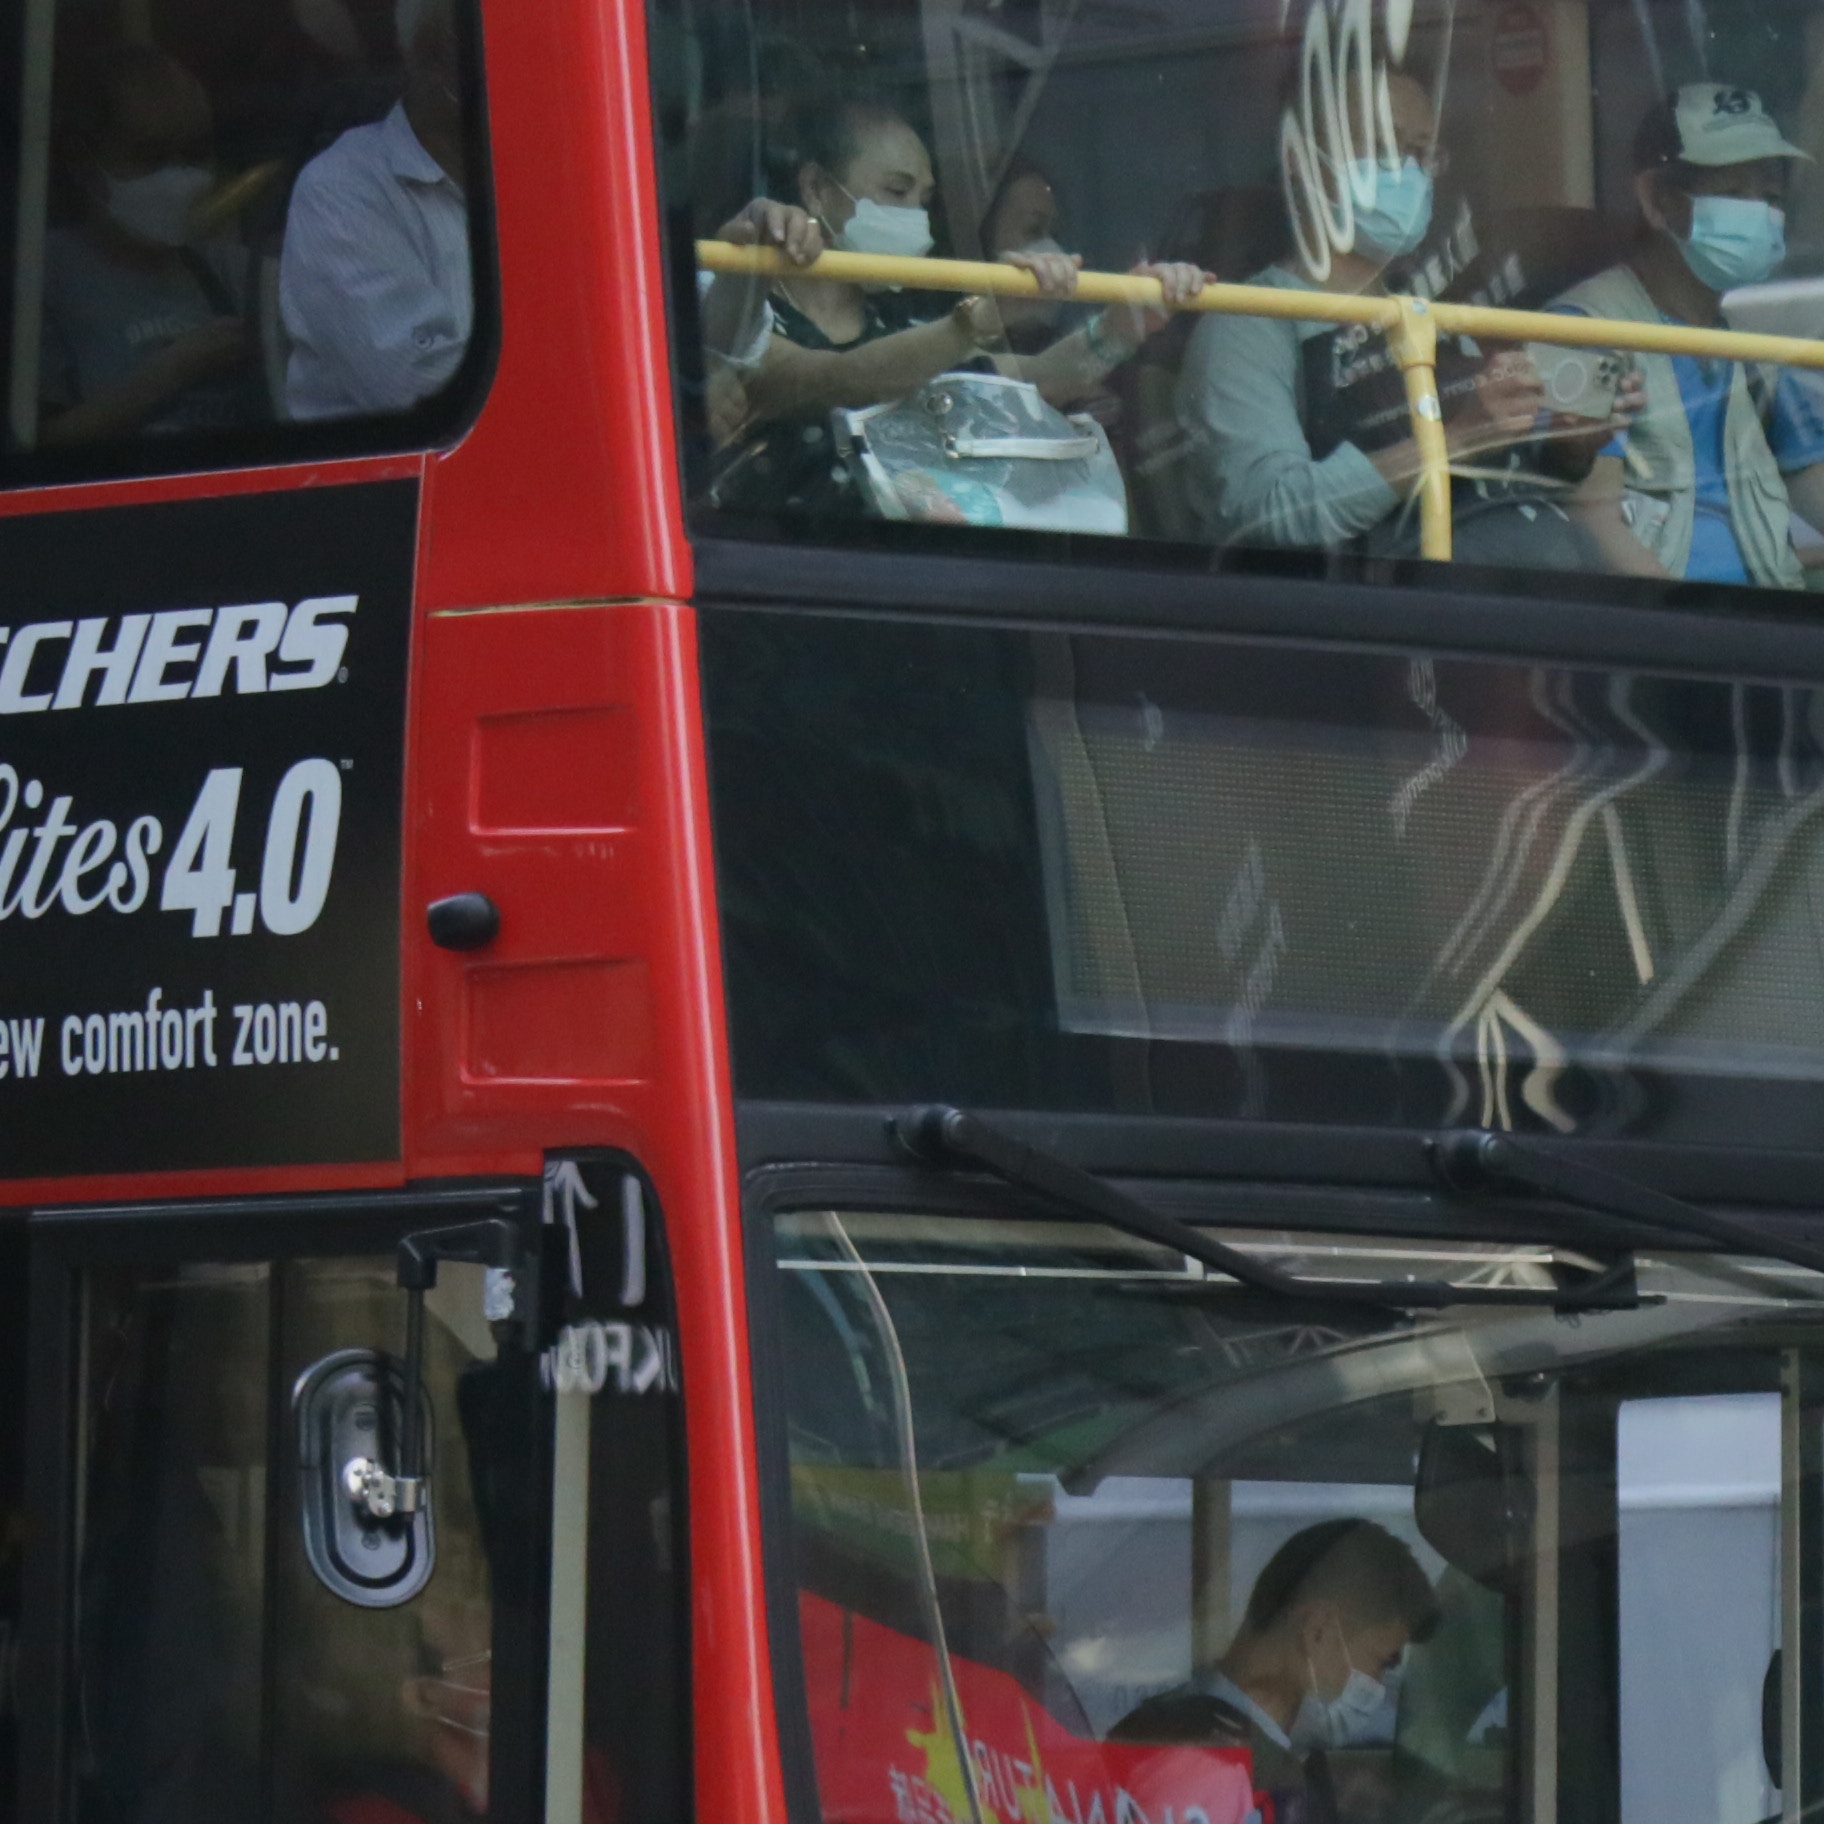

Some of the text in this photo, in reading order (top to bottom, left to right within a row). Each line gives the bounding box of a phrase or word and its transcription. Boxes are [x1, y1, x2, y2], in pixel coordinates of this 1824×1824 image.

[0, 595, 360, 714] CHERS
[160, 757, 342, 938] 4.0
[61, 986, 217, 1077] comfort
[232, 1000, 339, 1066] zone.
